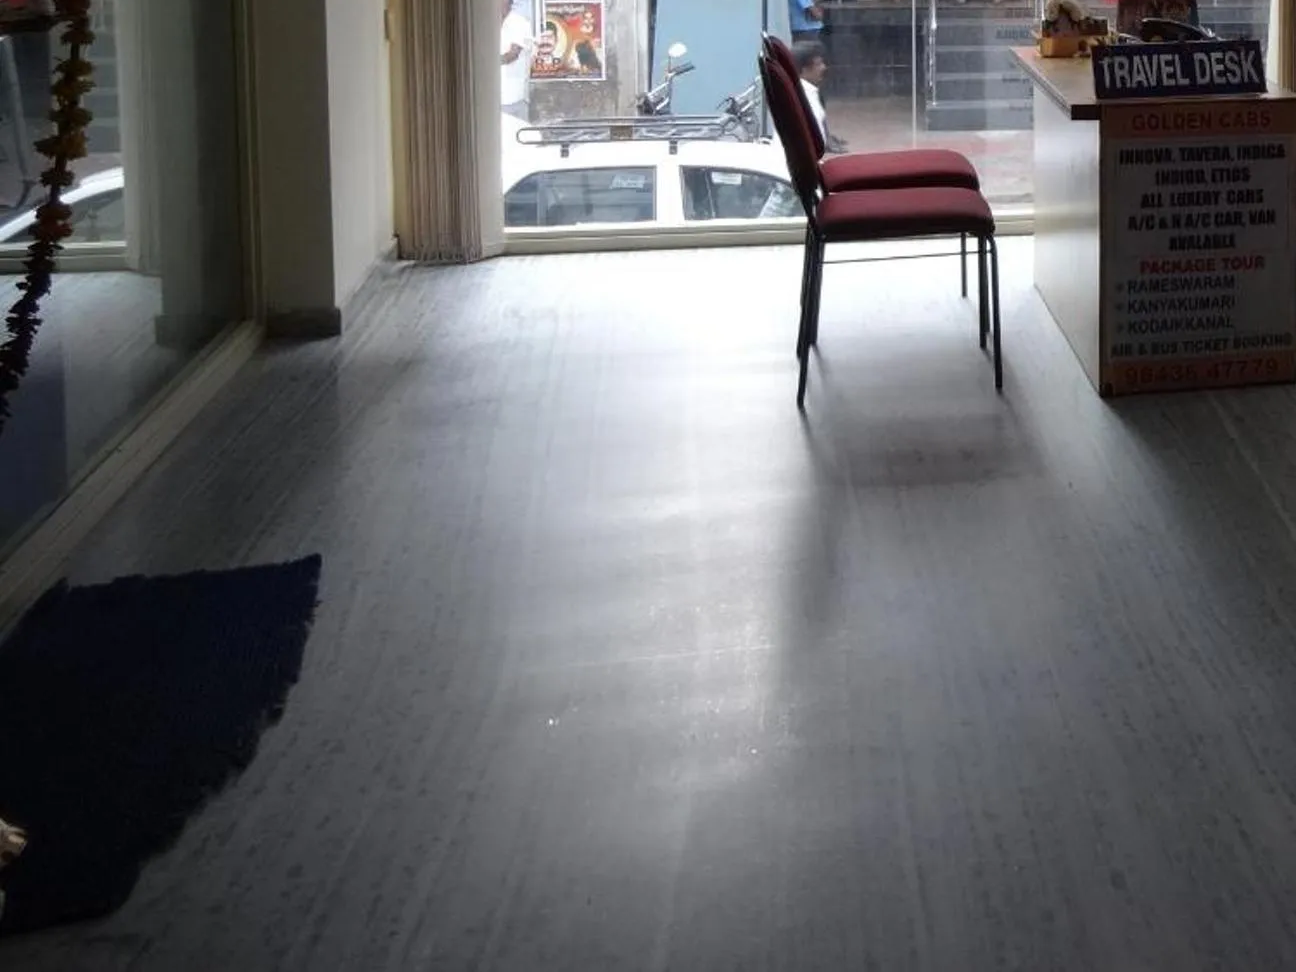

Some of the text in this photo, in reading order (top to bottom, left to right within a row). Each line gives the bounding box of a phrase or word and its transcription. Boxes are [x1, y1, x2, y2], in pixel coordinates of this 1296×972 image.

[1098, 49, 1259, 89] TRAVEL DESK
[1132, 110, 1271, 131] GOLDEN CABS
[1140, 193, 1163, 209] ALL
[1227, 189, 1264, 205] CARS
[1128, 215, 1155, 231] A/C
[1184, 212, 1211, 228] A/C
[1249, 209, 1276, 225] VAN
[1139, 256, 1265, 275] PACKAGE TOUR
[1127, 275, 1234, 295] RAMESWARAM
[1127, 295, 1236, 315] KANYAKUMARI
[1151, 340, 1178, 355] BUS
[1179, 337, 1229, 353] TICKET
[1233, 332, 1292, 350] BOOKING
